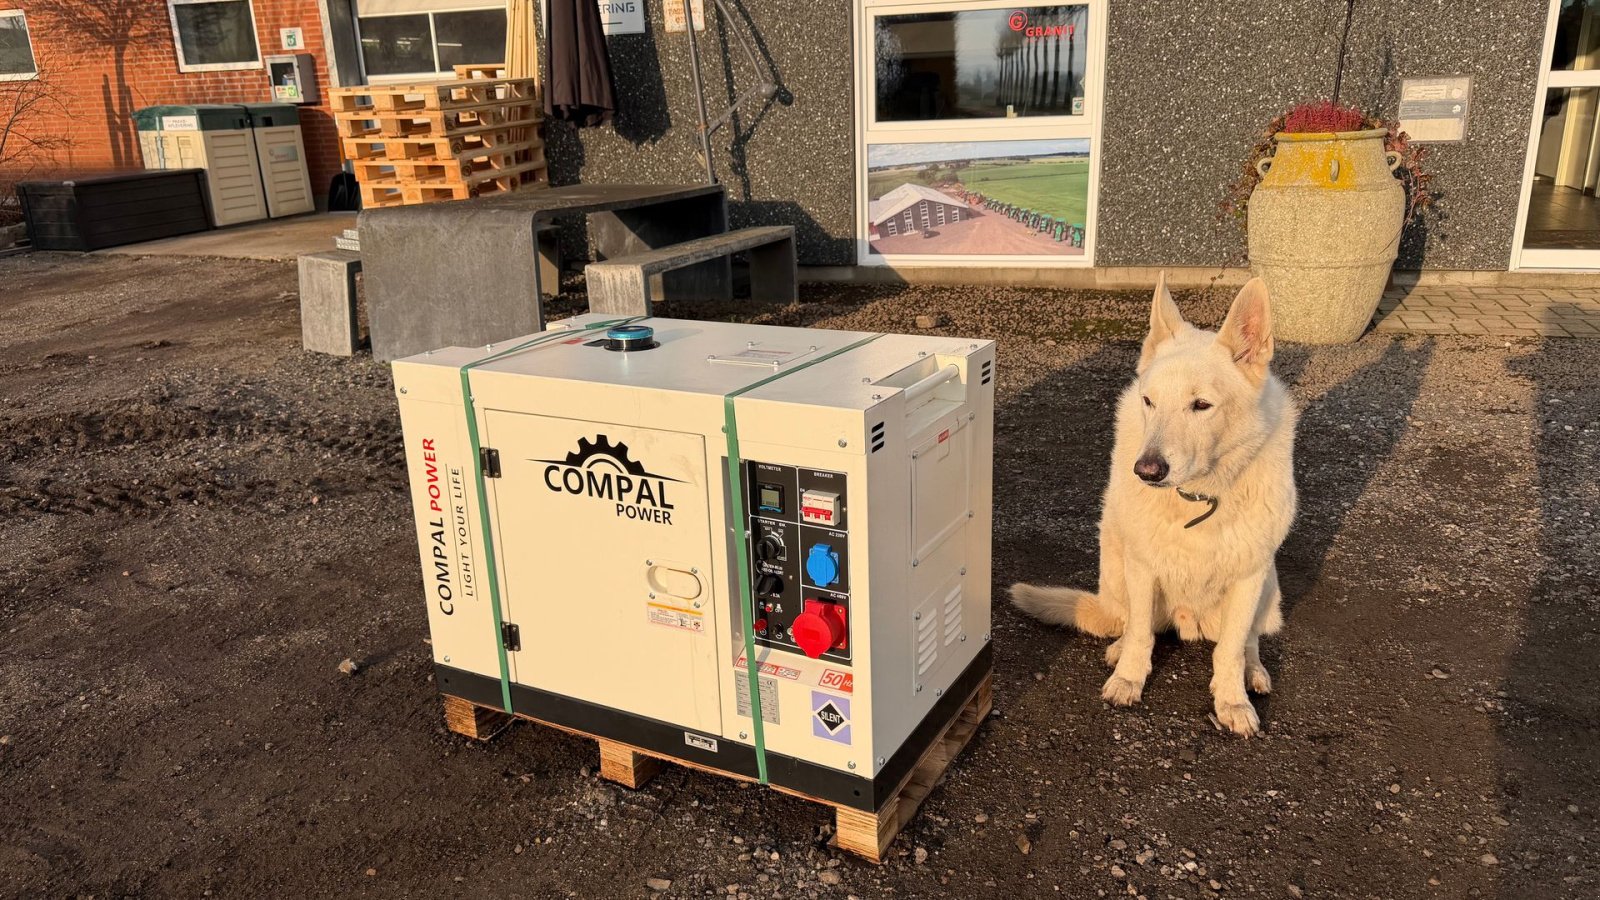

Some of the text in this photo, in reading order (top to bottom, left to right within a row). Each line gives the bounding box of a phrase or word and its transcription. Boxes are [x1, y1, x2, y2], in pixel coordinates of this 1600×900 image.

[1025, 25, 1074, 37] GRANIT
[758, 464, 782, 472] VOLTMETER
[813, 471, 834, 479] BREAKER
[544, 465, 674, 510] COMPAL
[616, 503, 673, 526] POWER
[422, 438, 454, 616] COMPAL POWER
[451, 468, 474, 597] LIGHT YOUR LIFE
[822, 671, 843, 686] 50
[820, 710, 841, 724] SILENT
